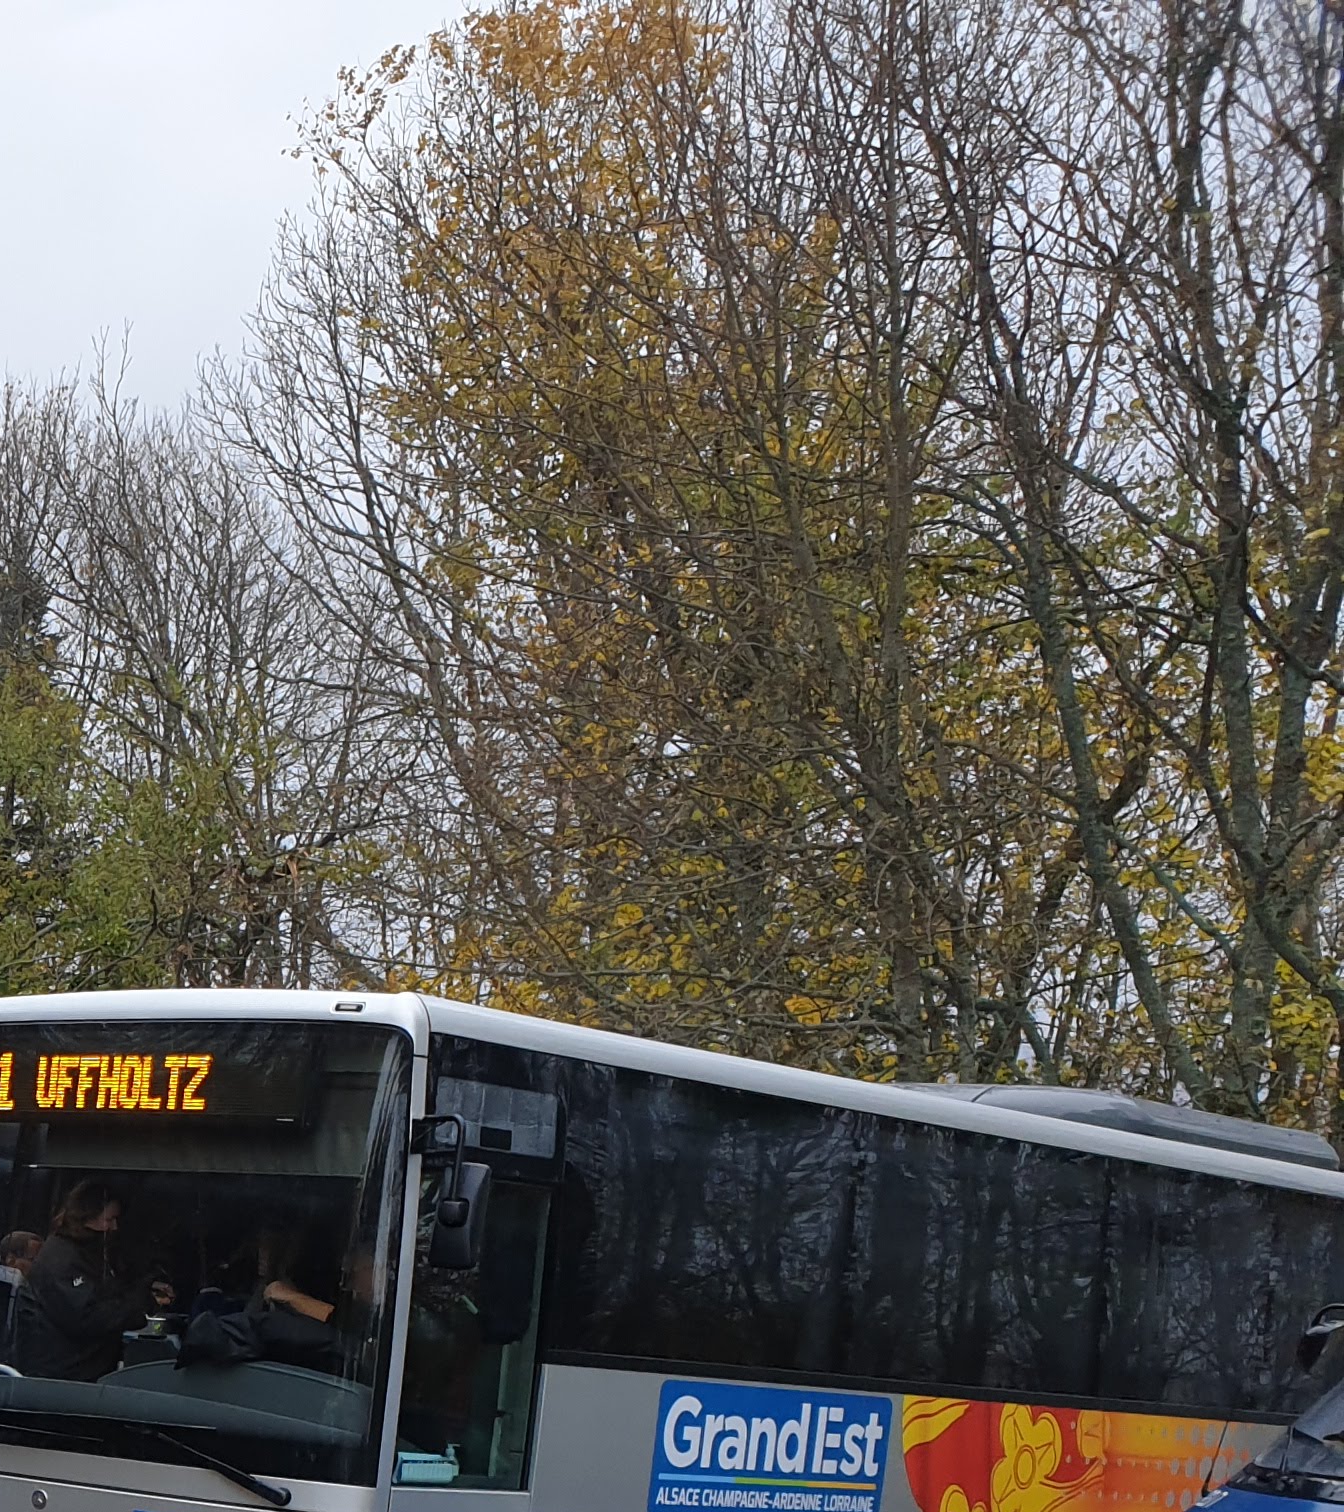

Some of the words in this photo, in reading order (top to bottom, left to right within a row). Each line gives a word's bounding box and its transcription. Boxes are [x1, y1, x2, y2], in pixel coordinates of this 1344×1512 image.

[35, 1054, 212, 1110] UFFHOLTZ
[655, 1486, 701, 1507] ALSACE
[701, 1488, 823, 1512] CHAMPAGNE-ARDENNE
